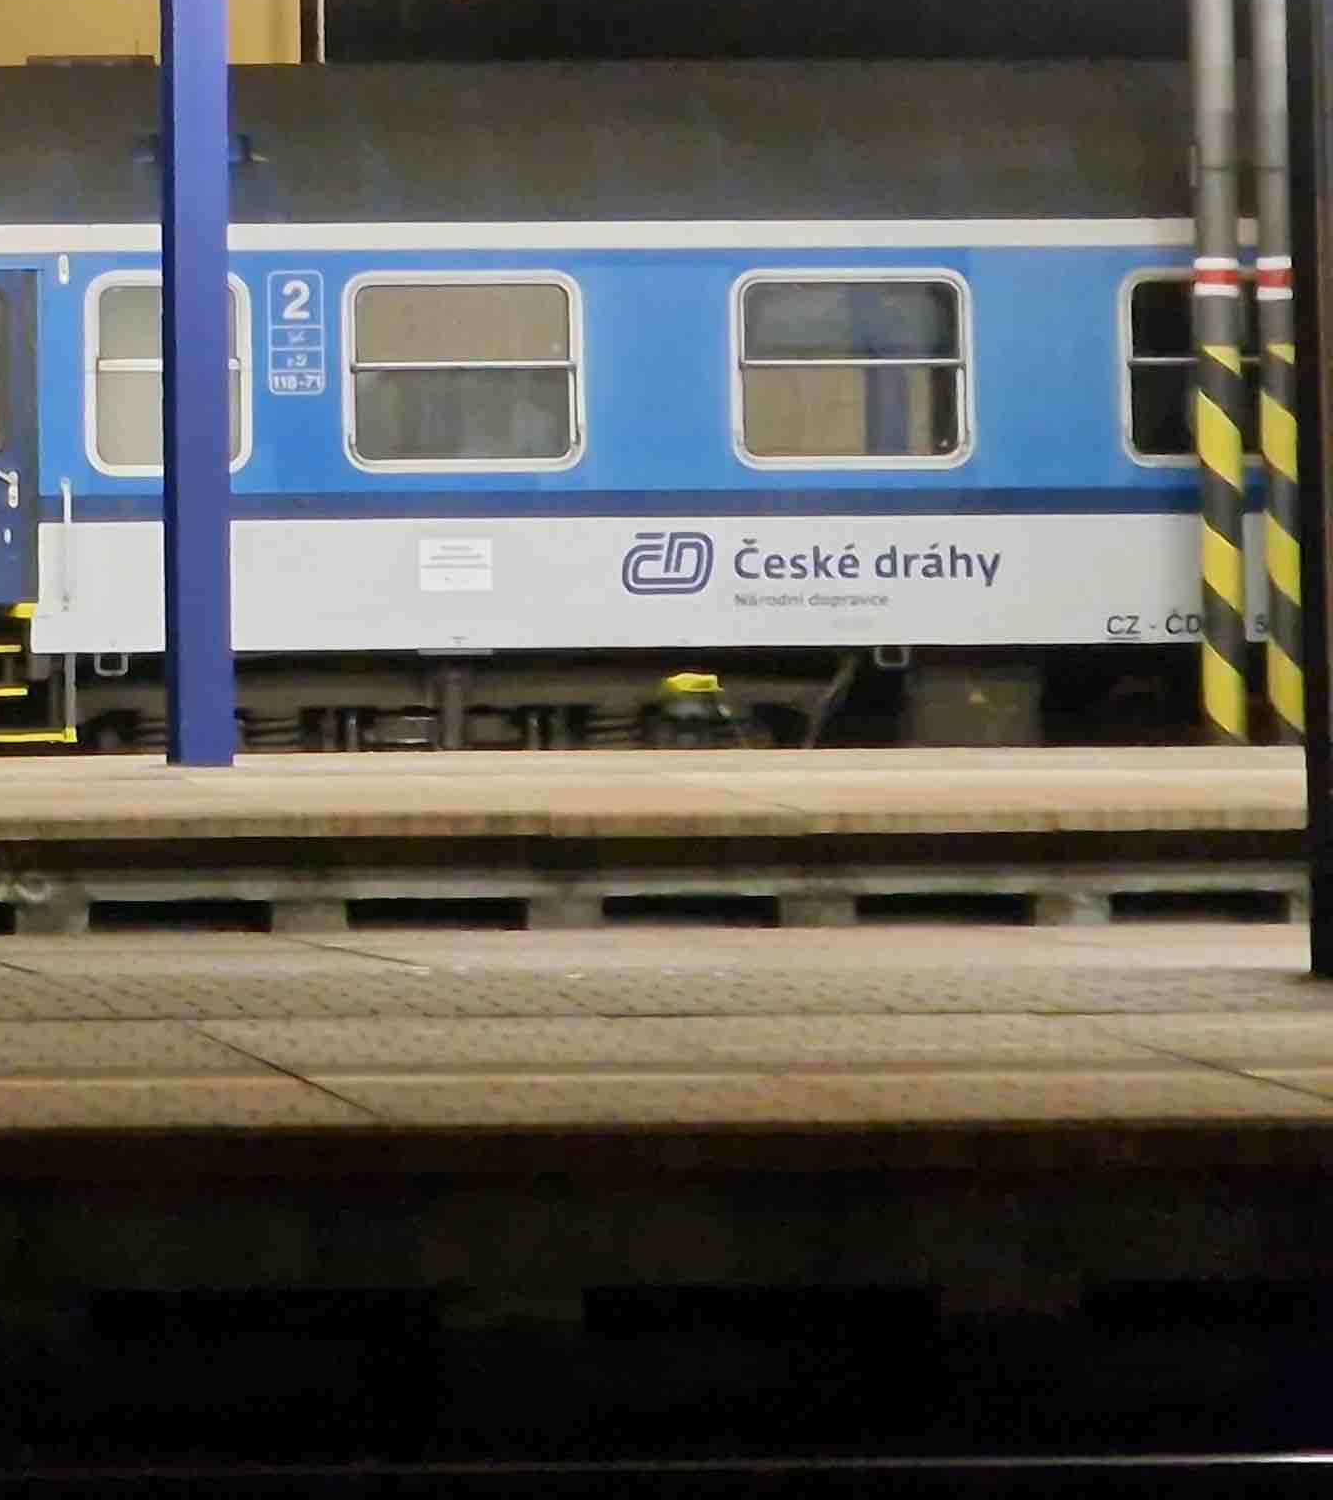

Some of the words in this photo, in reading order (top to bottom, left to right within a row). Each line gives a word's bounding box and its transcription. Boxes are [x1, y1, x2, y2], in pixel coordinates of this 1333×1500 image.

[282, 279, 310, 319] 2
[734, 538, 861, 579] České
[874, 542, 1001, 587] dráhy
[1107, 615, 1141, 635] CZ
